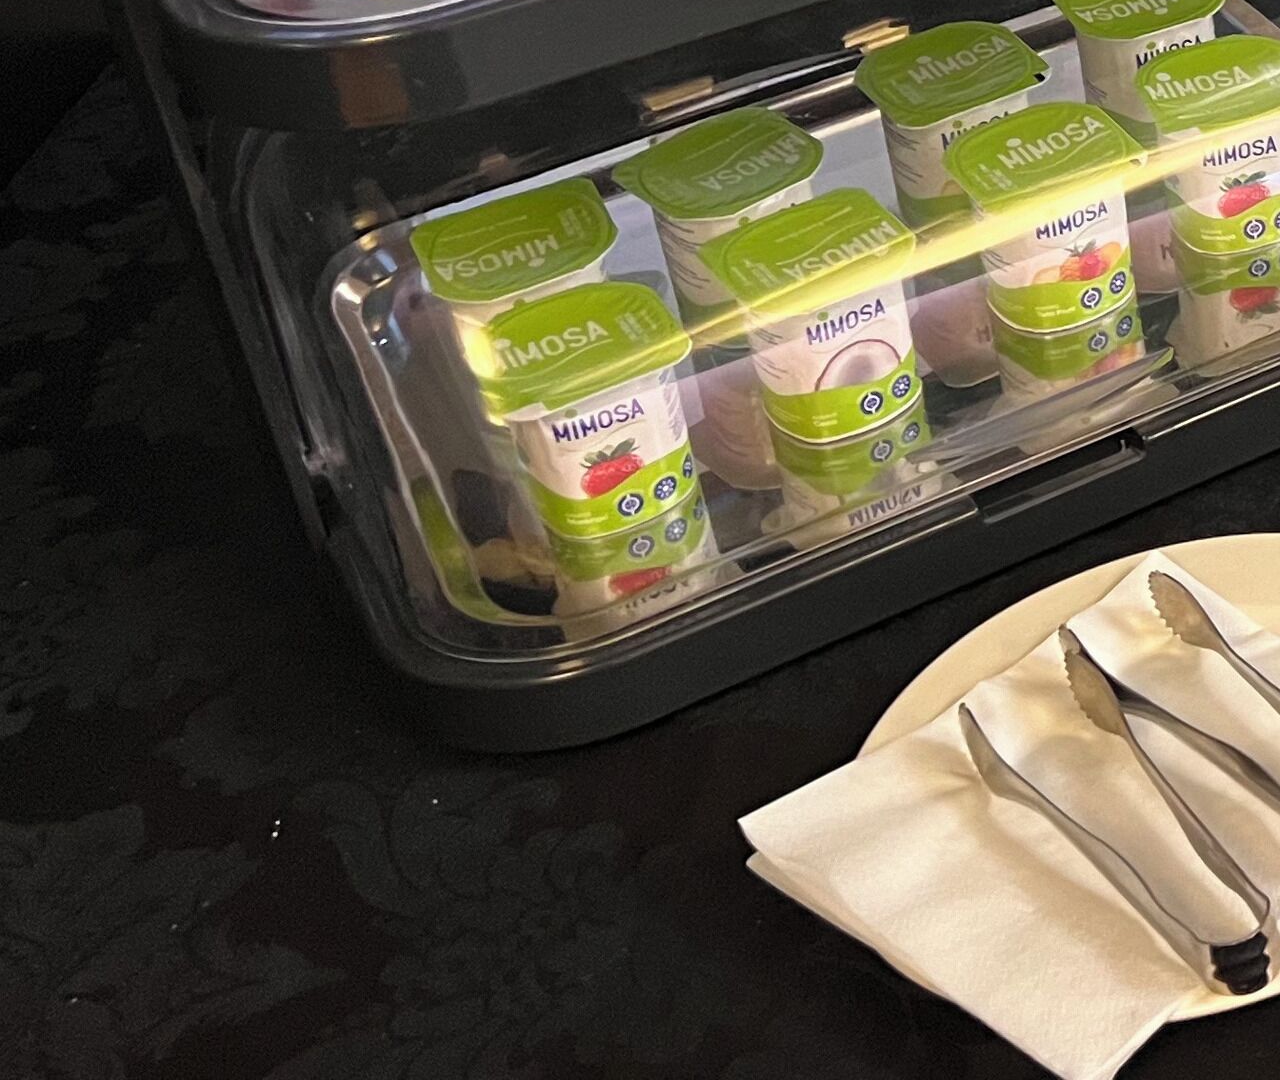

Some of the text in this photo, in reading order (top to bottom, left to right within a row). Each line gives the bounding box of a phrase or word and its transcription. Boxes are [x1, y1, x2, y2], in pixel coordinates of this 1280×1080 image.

[908, 35, 1011, 84] MIMOSA
[1144, 65, 1251, 101] MIMOSA
[998, 115, 1104, 169] MIMOSA
[1203, 136, 1277, 167] MIMOSA
[1036, 201, 1108, 240] MIMOSA
[434, 233, 559, 281] MIMOSA
[782, 220, 898, 279] MIMOSA
[806, 298, 886, 346] MIMOSA
[492, 320, 608, 374] IMOSA
[551, 398, 645, 443] MIMOSA
